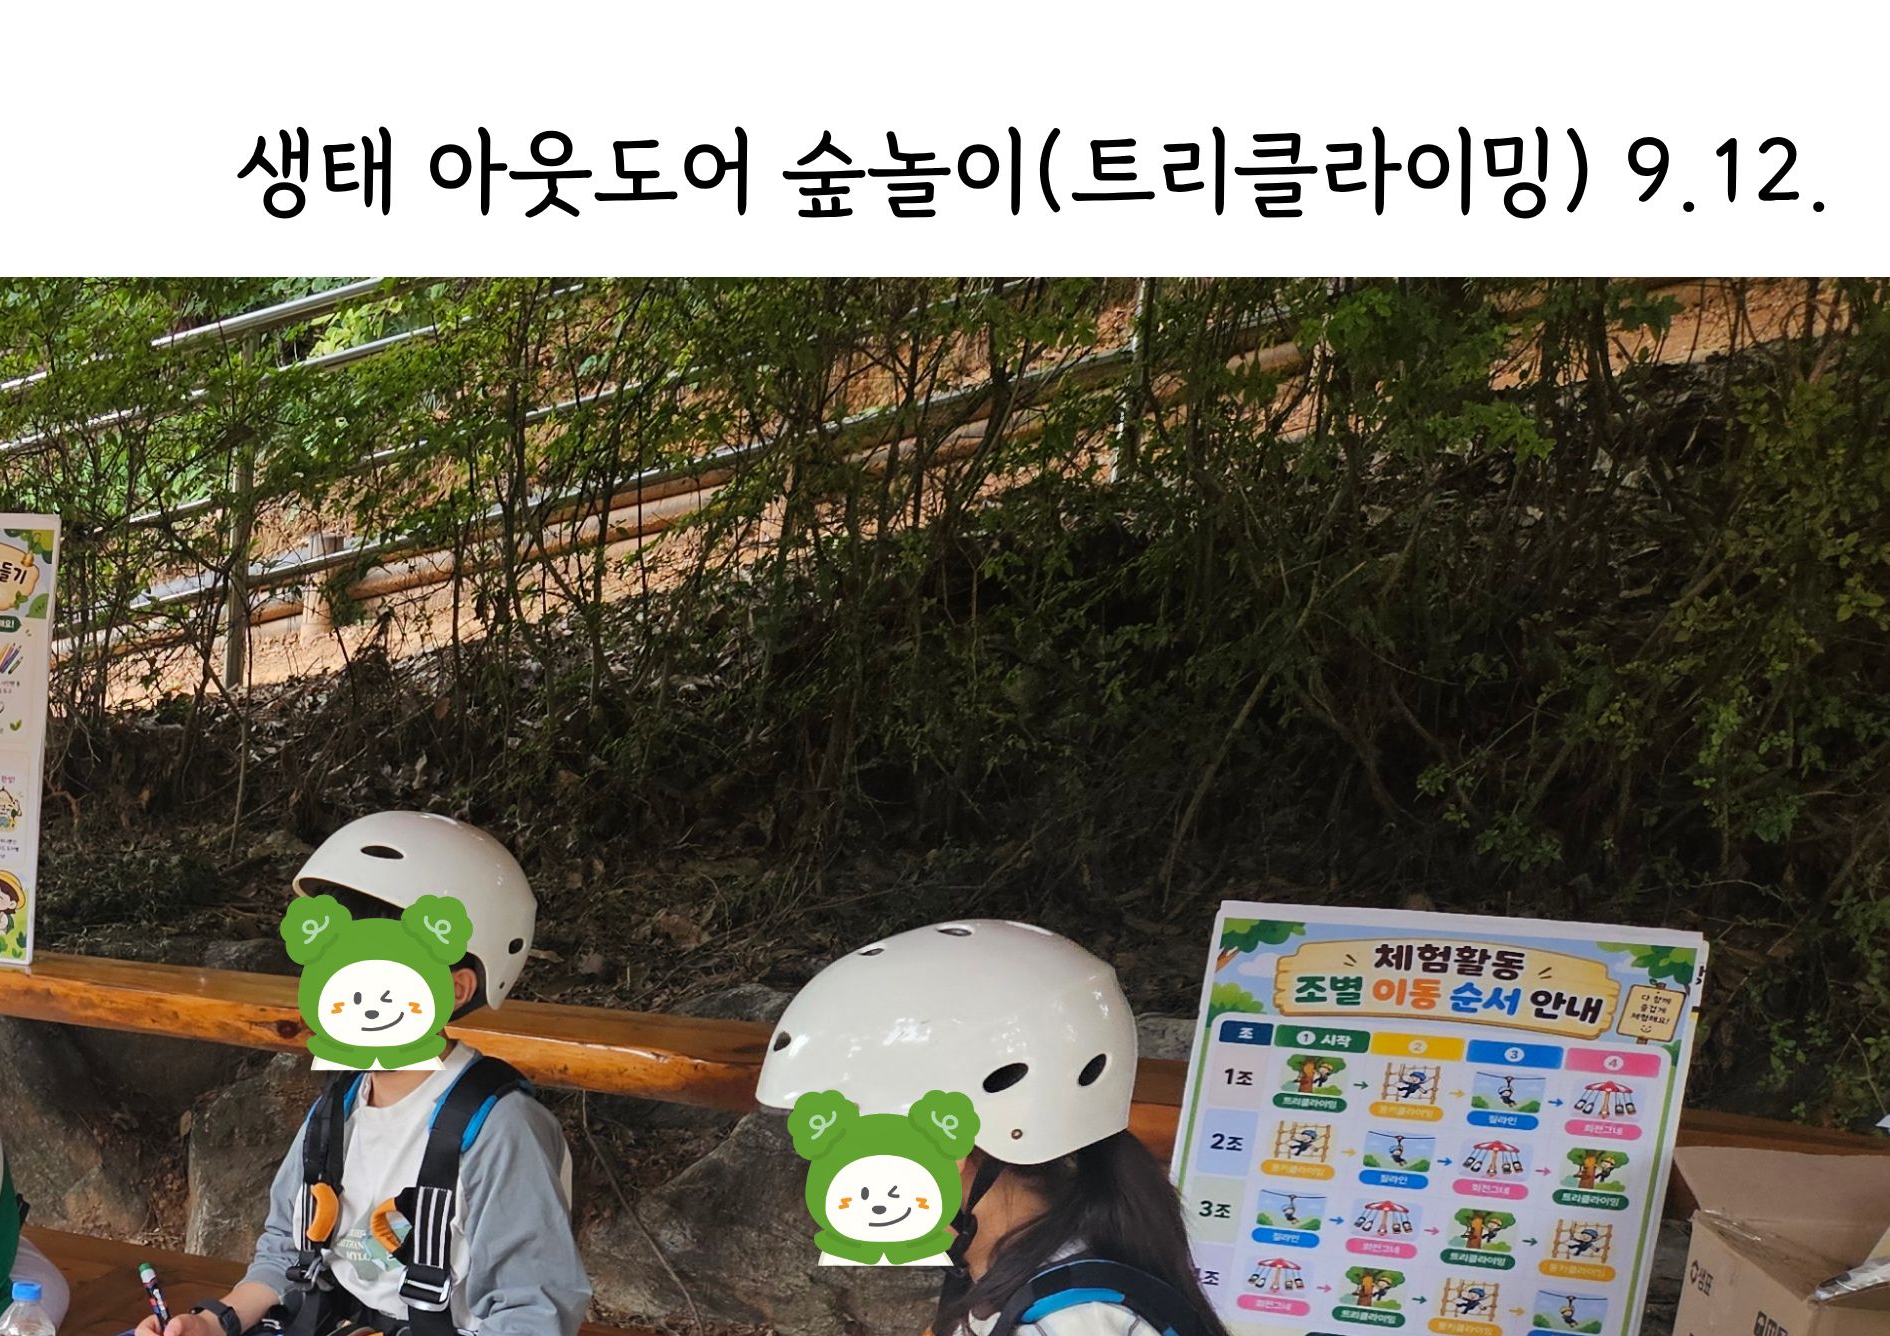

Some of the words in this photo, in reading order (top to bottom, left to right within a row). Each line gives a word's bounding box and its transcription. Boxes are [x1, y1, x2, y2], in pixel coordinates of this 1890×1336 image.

[1374, 944, 1525, 981] 체험활동
[1294, 975, 1363, 1006] 조별
[1373, 978, 1442, 1010] 이동
[1450, 982, 1522, 1015] 순서
[1530, 990, 1603, 1024] 안내
[1653, 995, 1672, 1005] 함께
[1238, 1027, 1253, 1040] 조
[1320, 1033, 1352, 1047] 시작
[1224, 1068, 1253, 1086] 1조
[1283, 1096, 1338, 1110] 트리클라이밍
[1210, 1133, 1244, 1152] 2조
[1561, 1192, 1620, 1208] 트리클라이밍
[1199, 1200, 1231, 1219] 3조
[1450, 1252, 1507, 1266] 트리클라이밍
[1696, 1267, 1714, 1297] 샘표
[1341, 1309, 1397, 1324] 트리클라이밍
